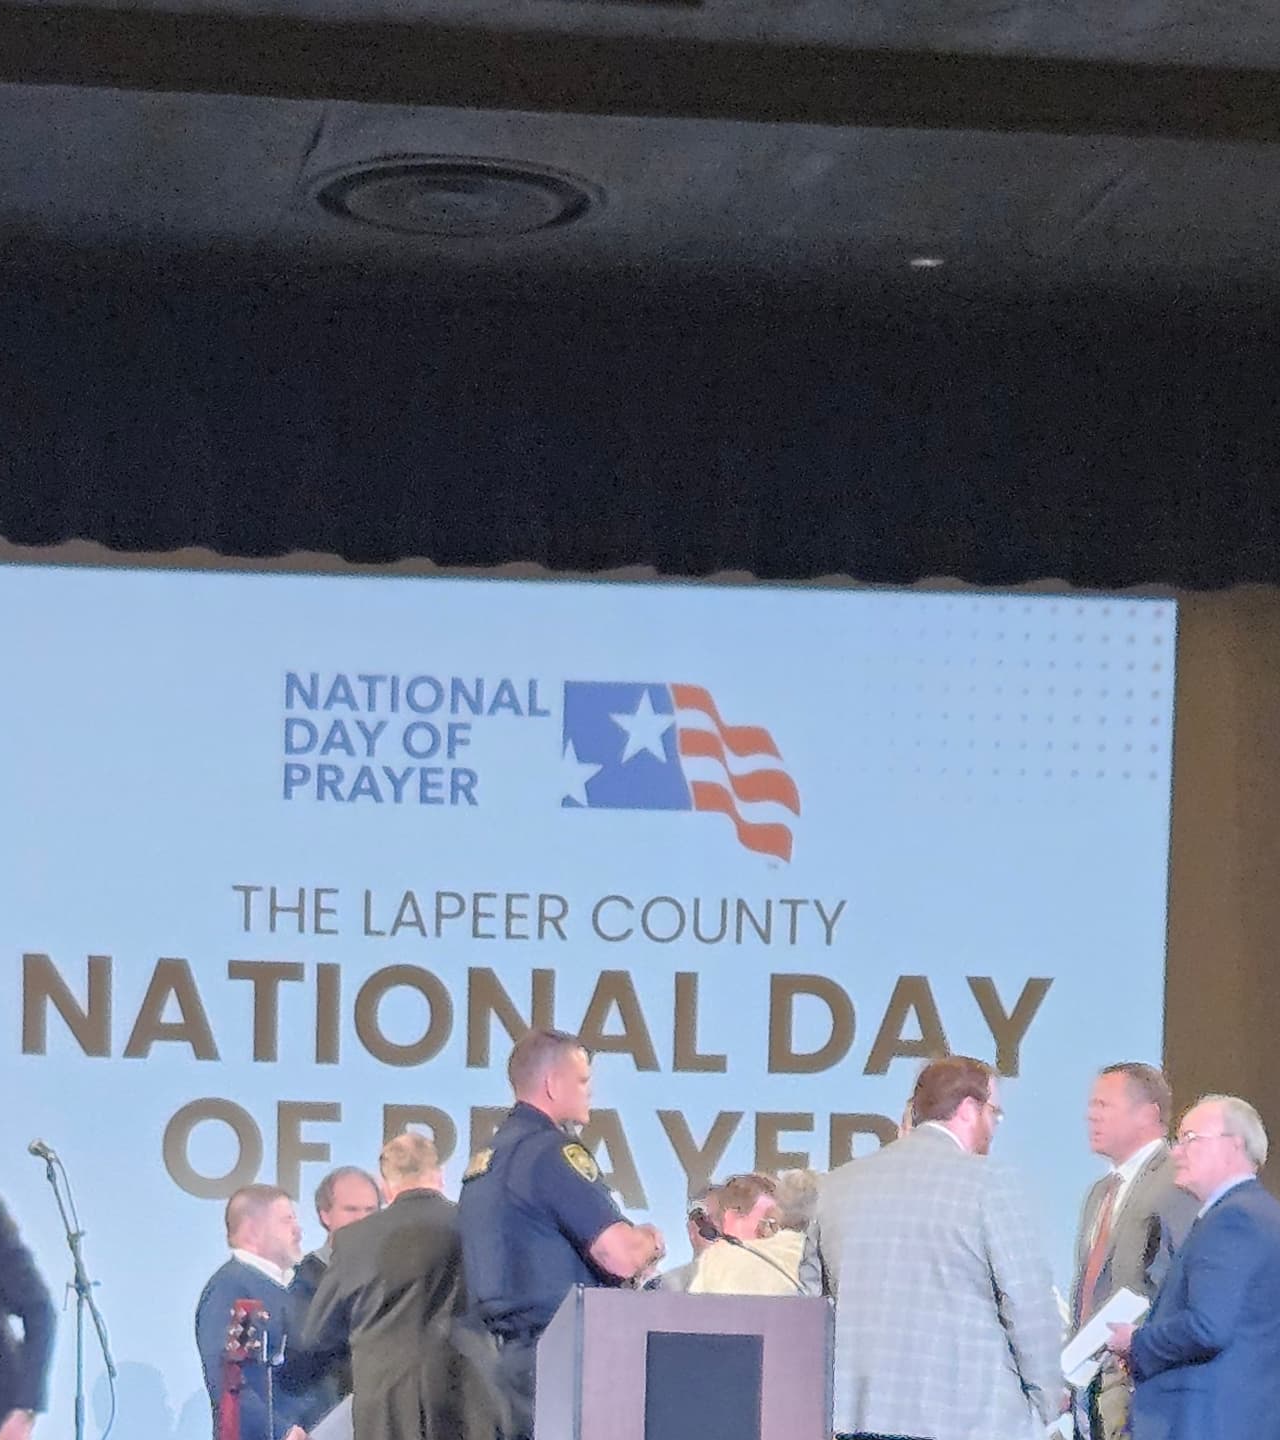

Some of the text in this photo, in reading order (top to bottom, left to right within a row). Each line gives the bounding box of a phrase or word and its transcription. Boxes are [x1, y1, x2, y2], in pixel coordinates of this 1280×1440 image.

[284, 671, 552, 718] NATIONAL
[284, 717, 472, 760] DAY OF
[282, 762, 479, 807] PRAYER
[231, 884, 848, 947] THE LAPEER COUNTY
[21, 952, 1055, 1078] NATIONAL DAY
[162, 1097, 342, 1202] OF
